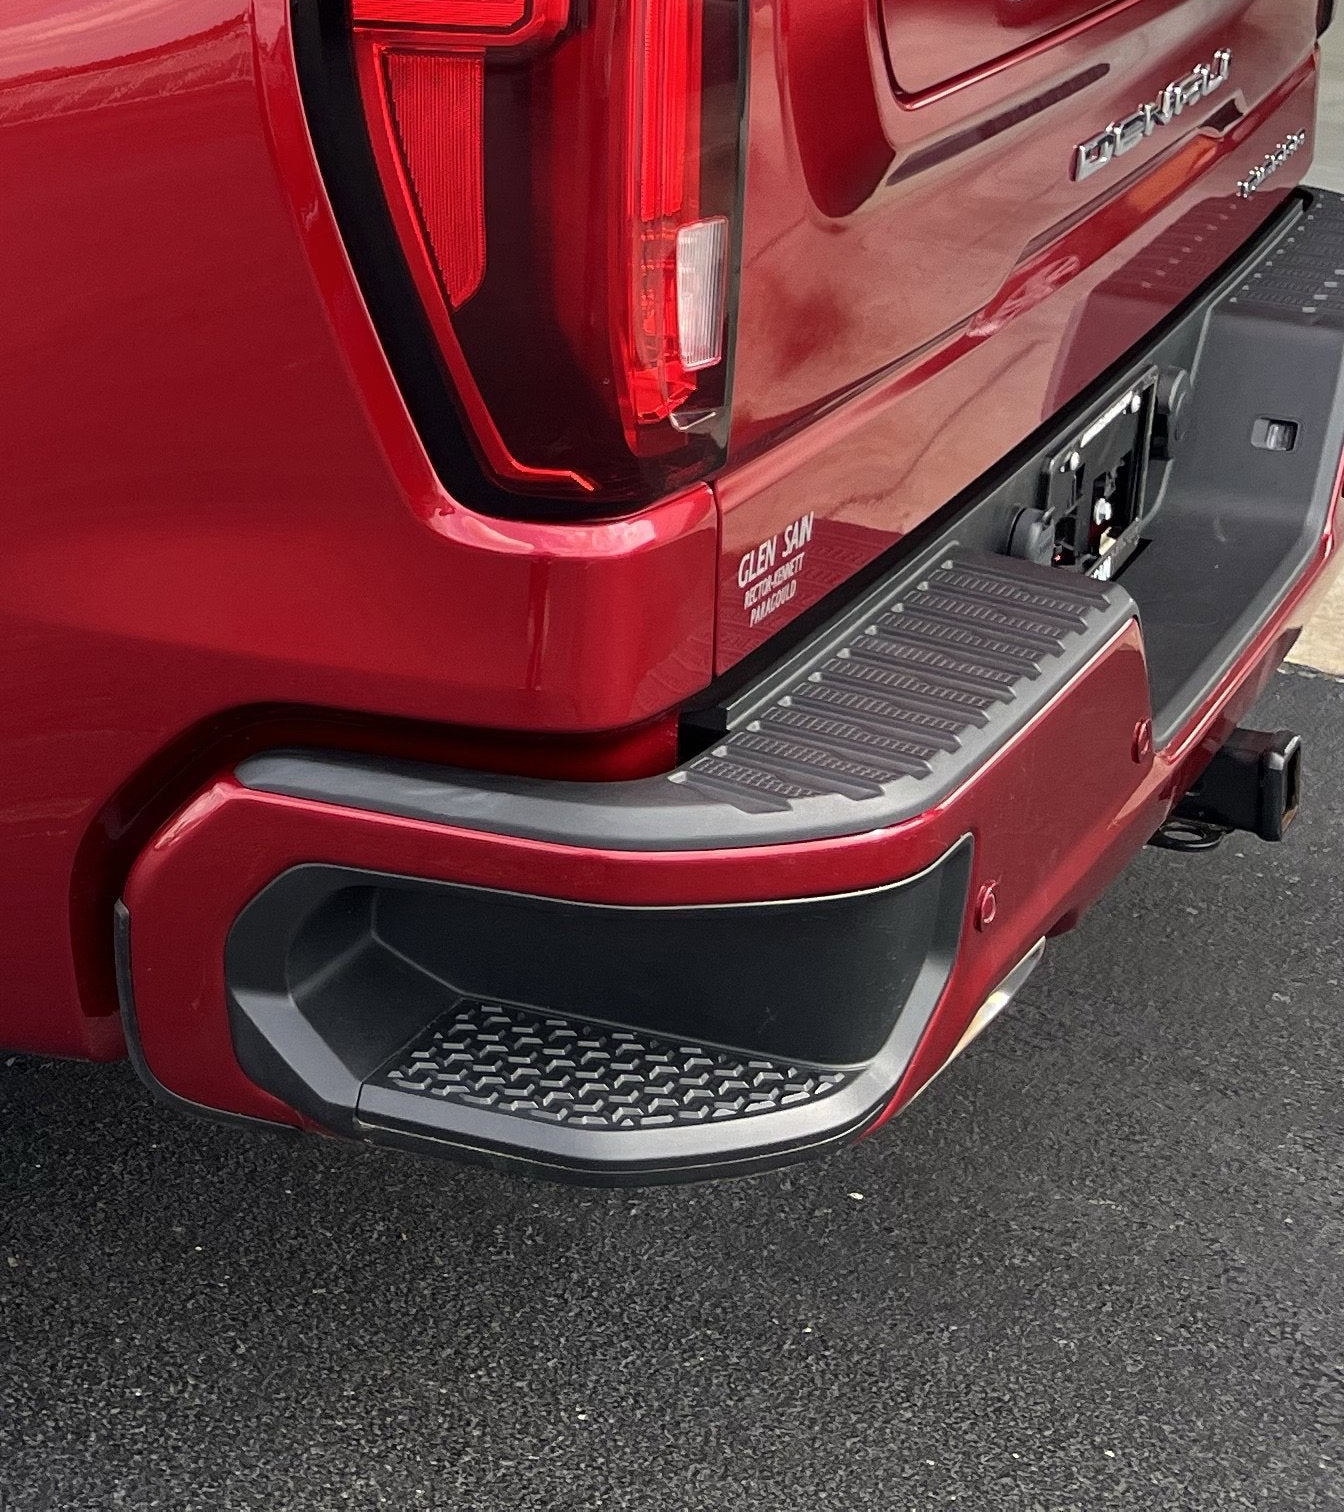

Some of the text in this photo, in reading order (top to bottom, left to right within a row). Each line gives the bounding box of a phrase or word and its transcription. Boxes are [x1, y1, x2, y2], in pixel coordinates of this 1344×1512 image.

[1070, 47, 1232, 182] DENALI
[738, 510, 815, 588] GLEN SAIN
